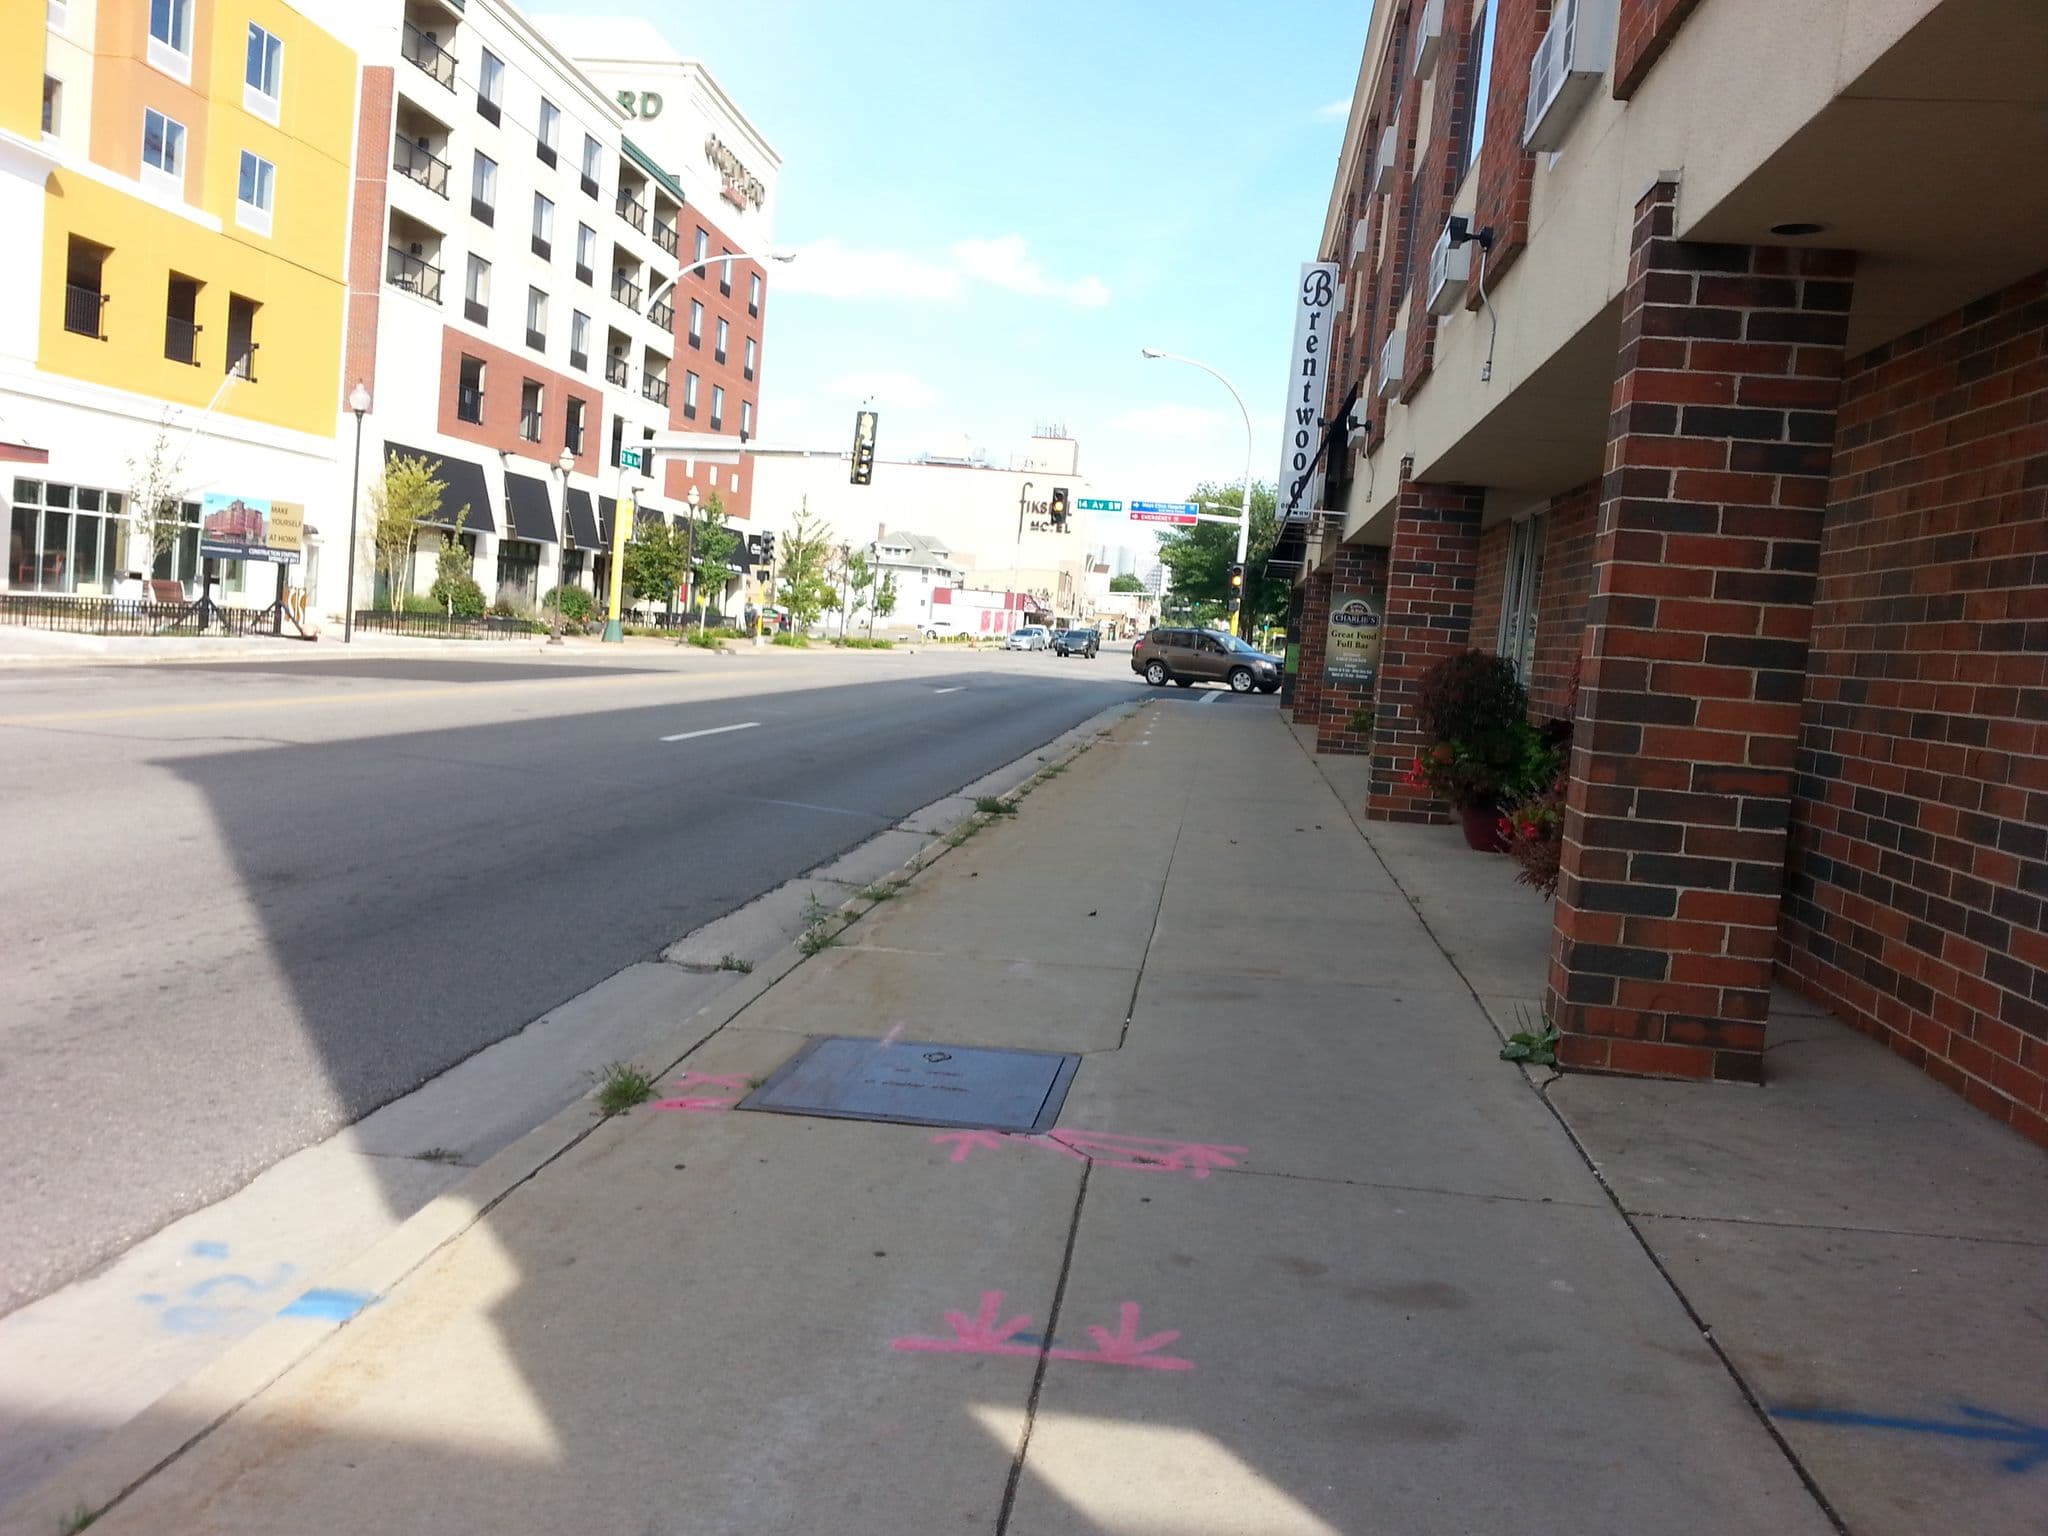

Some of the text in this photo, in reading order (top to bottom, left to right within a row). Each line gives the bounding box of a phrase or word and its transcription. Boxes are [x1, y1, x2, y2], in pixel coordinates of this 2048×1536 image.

[1289, 269, 1333, 501] Brentwood
[1078, 499, 1088, 509] 14
[271, 506, 288, 515] MAKE
[272, 518, 302, 528] YOURSELF
[269, 533, 277, 541] AT
[1331, 629, 1377, 640] Great Food
[1336, 639, 1369, 649] Full Bar
